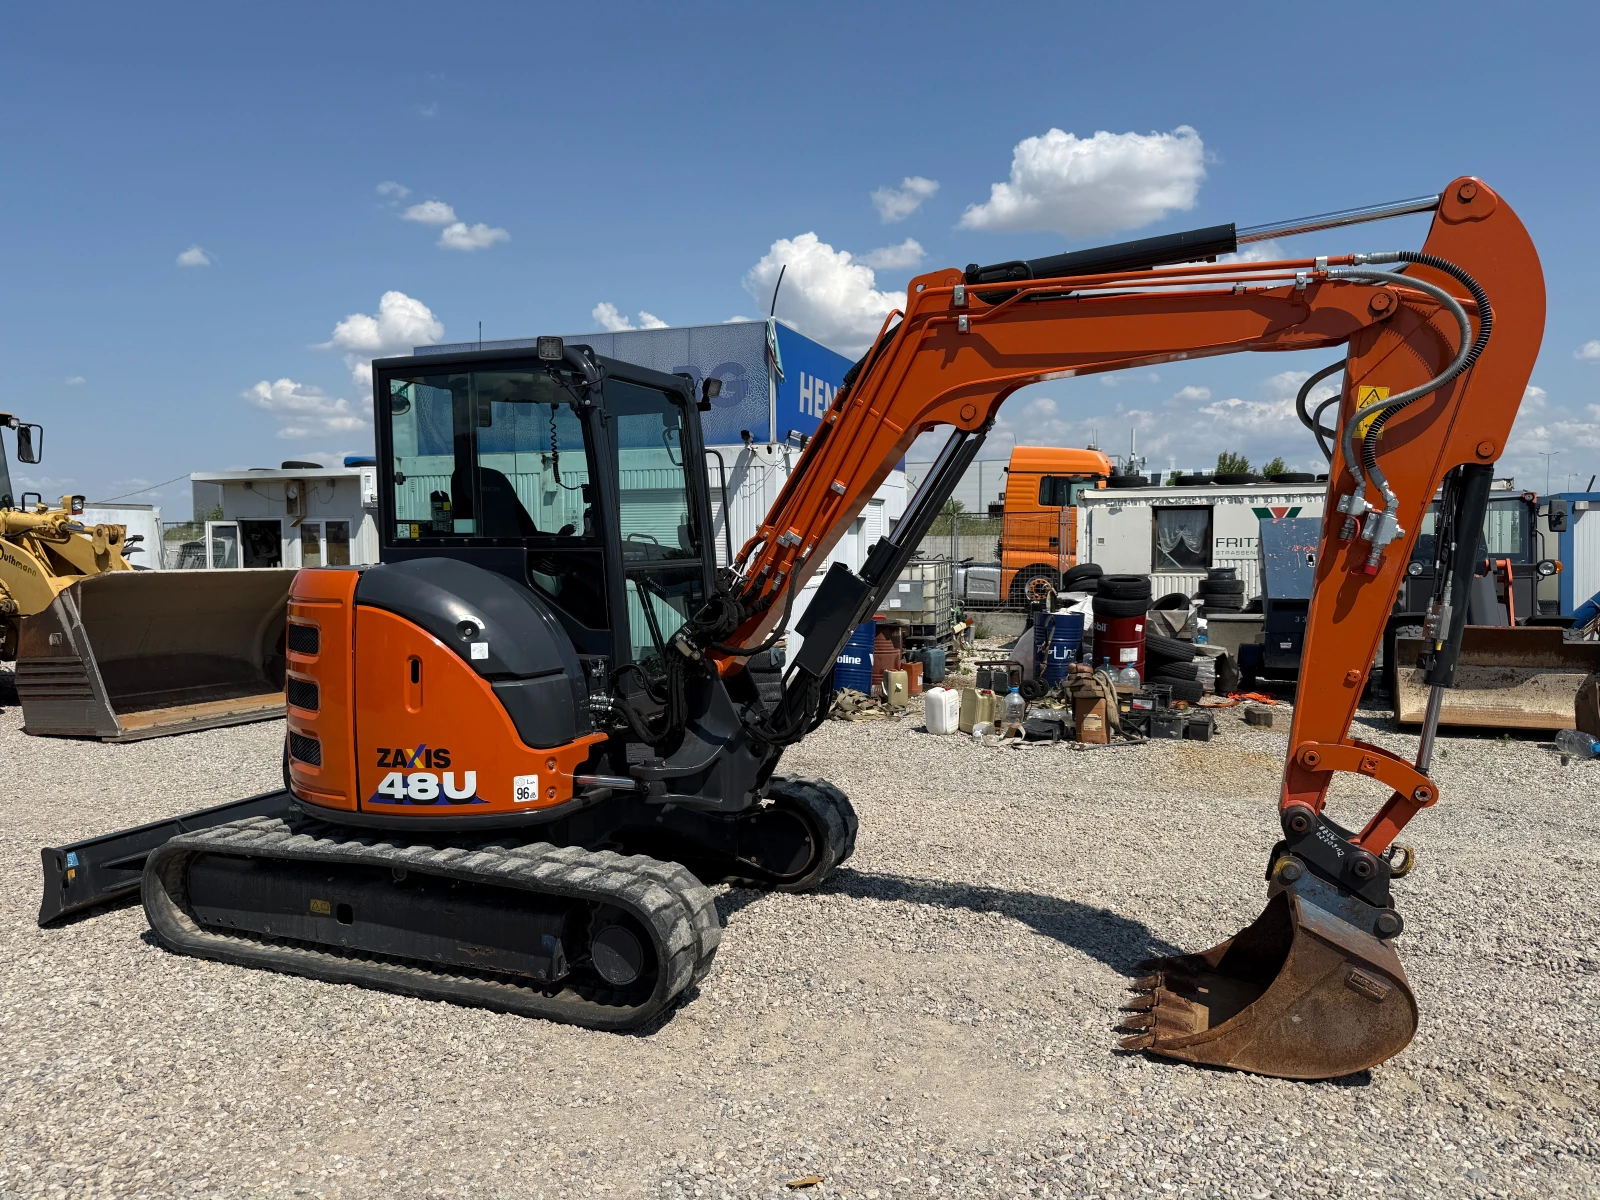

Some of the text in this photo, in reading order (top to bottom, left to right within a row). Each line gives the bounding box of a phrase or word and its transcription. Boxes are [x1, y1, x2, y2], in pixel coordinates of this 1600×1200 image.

[376, 744, 452, 769] ZAXIS
[377, 771, 477, 804] 48U
[516, 786, 530, 800] 96
